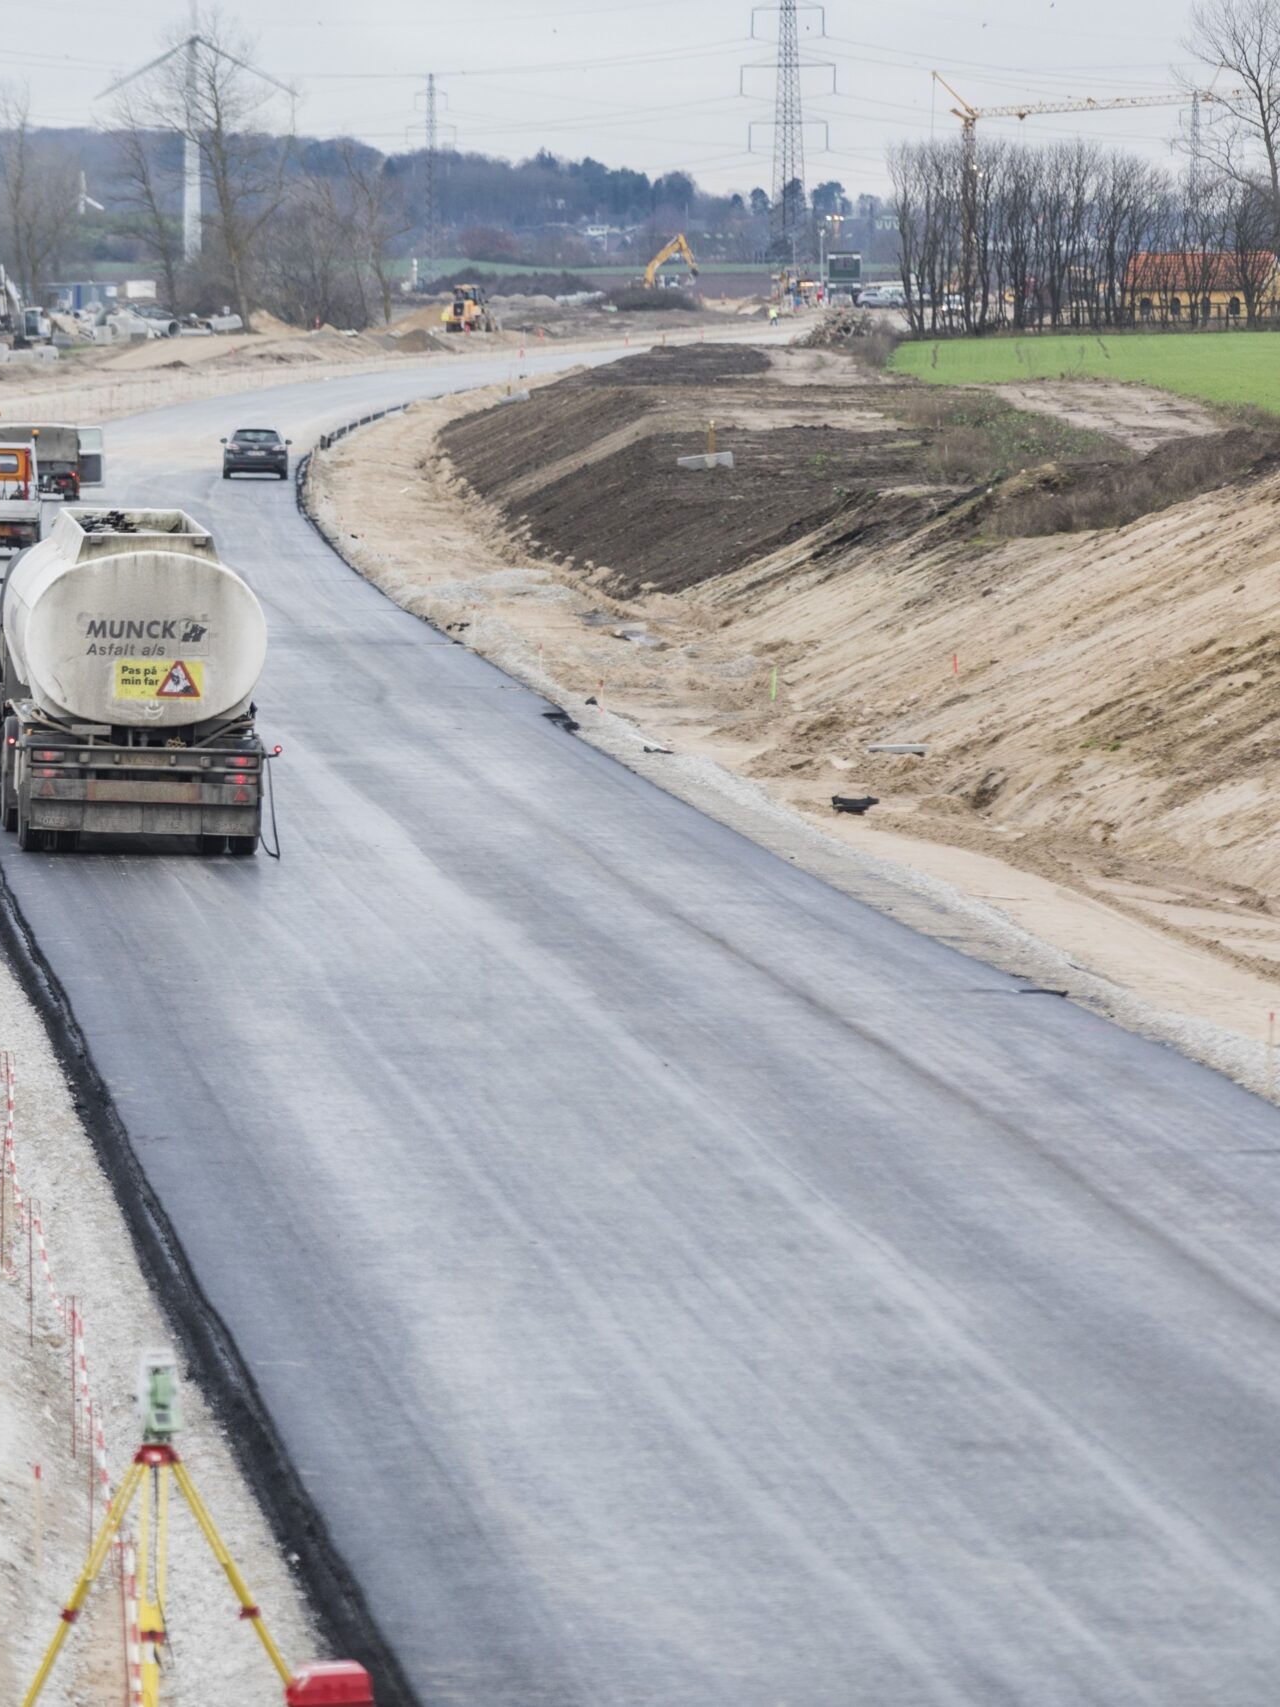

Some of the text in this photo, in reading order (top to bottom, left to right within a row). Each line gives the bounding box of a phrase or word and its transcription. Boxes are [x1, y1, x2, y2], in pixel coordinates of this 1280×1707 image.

[86, 619, 177, 639] MUNCK
[86, 643, 165, 656] Asfalt a/s
[121, 665, 157, 677] Pas på
[121, 676, 160, 686] min far
